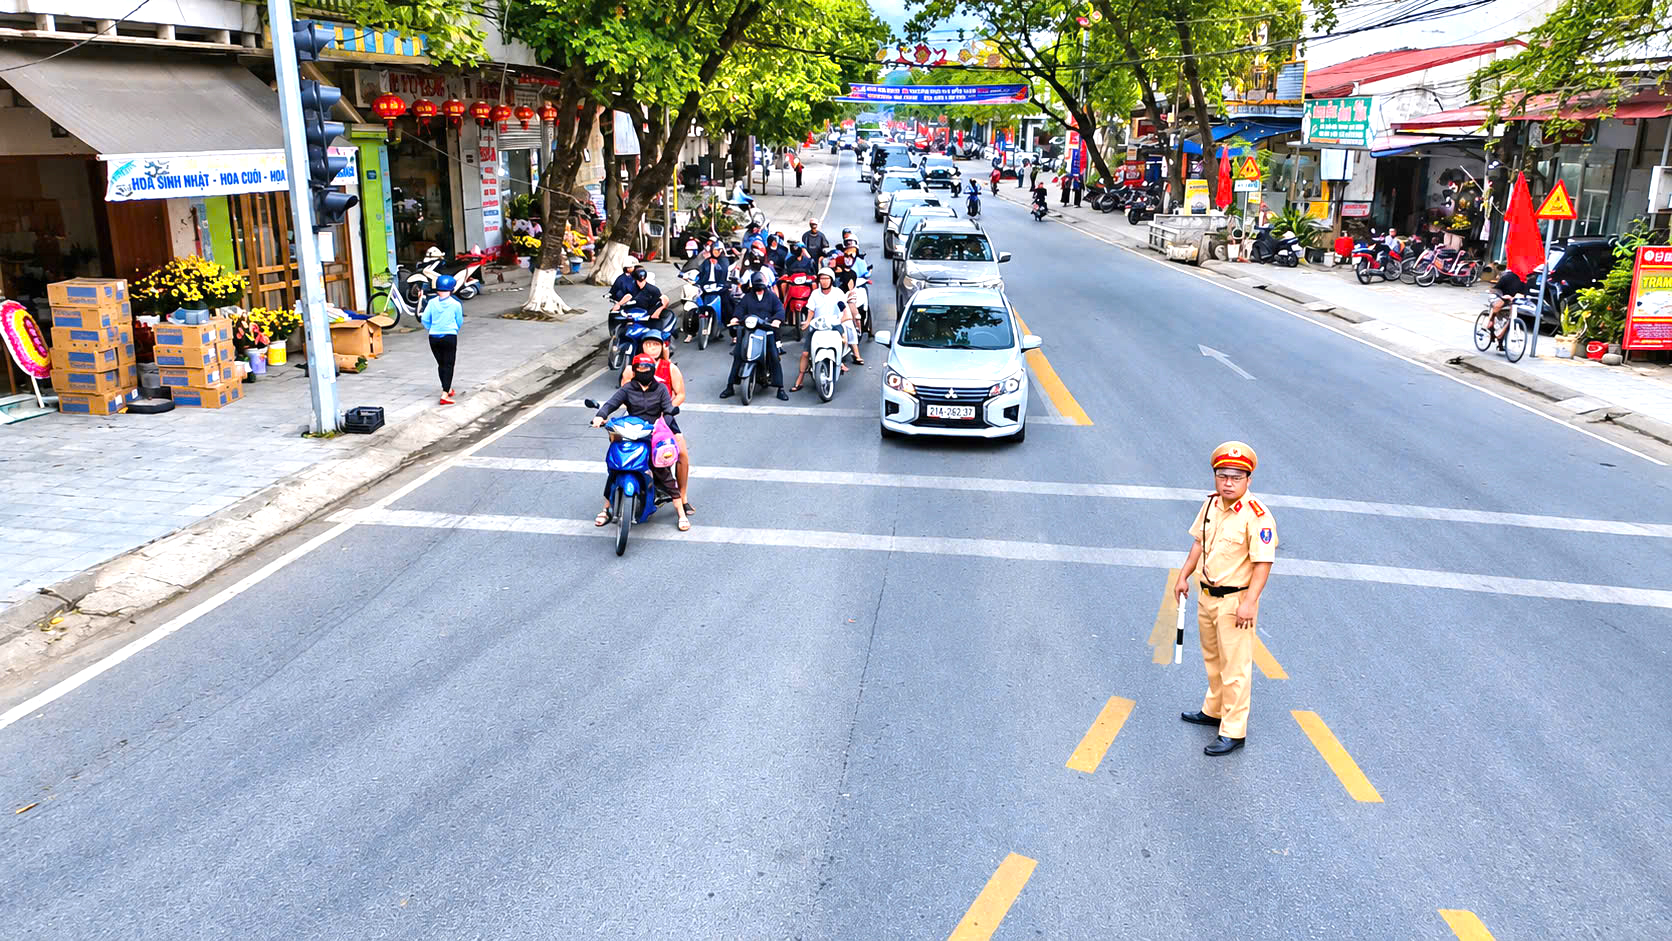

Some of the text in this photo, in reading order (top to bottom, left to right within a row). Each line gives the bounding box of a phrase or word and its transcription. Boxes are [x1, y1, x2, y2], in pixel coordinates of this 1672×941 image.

[131, 176, 155, 191] HOA
[157, 174, 181, 189] SINH
[220, 172, 239, 185] HOA
